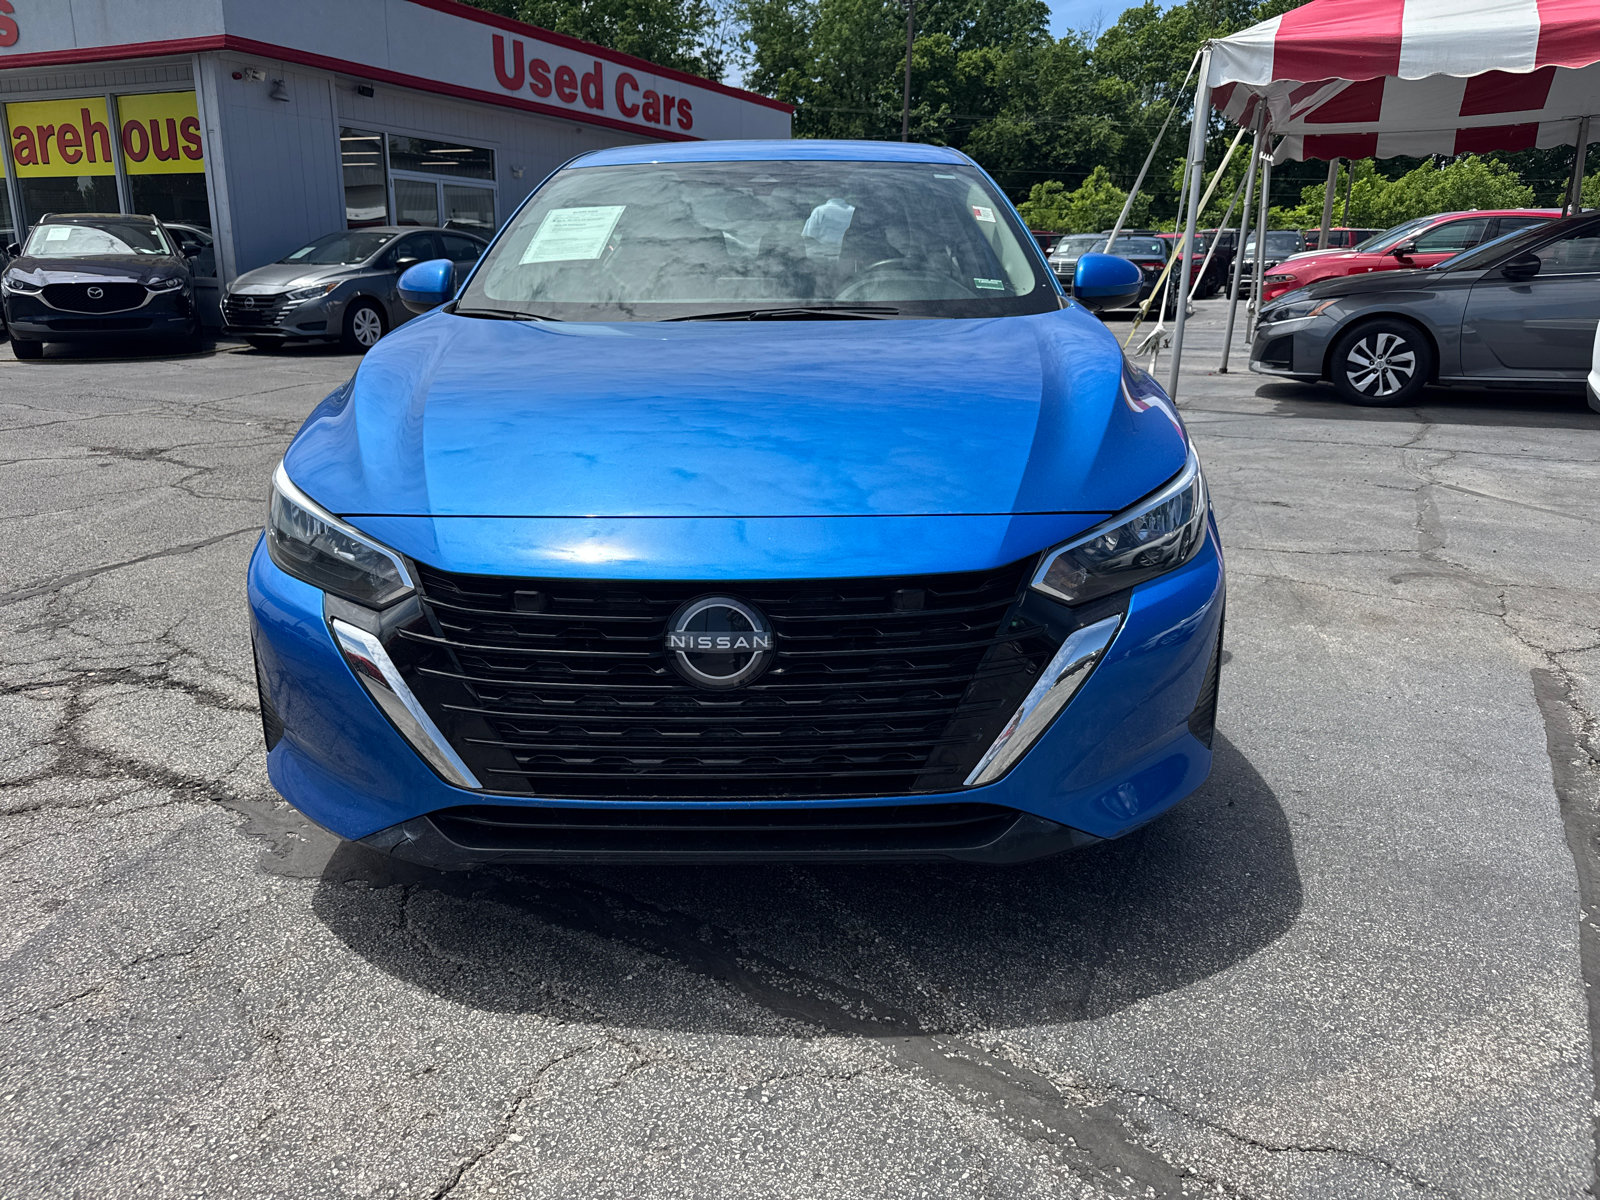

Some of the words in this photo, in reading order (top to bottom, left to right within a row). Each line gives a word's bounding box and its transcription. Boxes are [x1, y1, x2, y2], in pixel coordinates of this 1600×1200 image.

[492, 33, 604, 110] Used
[615, 72, 693, 130] Cars
[670, 635, 768, 649] NISSAN
